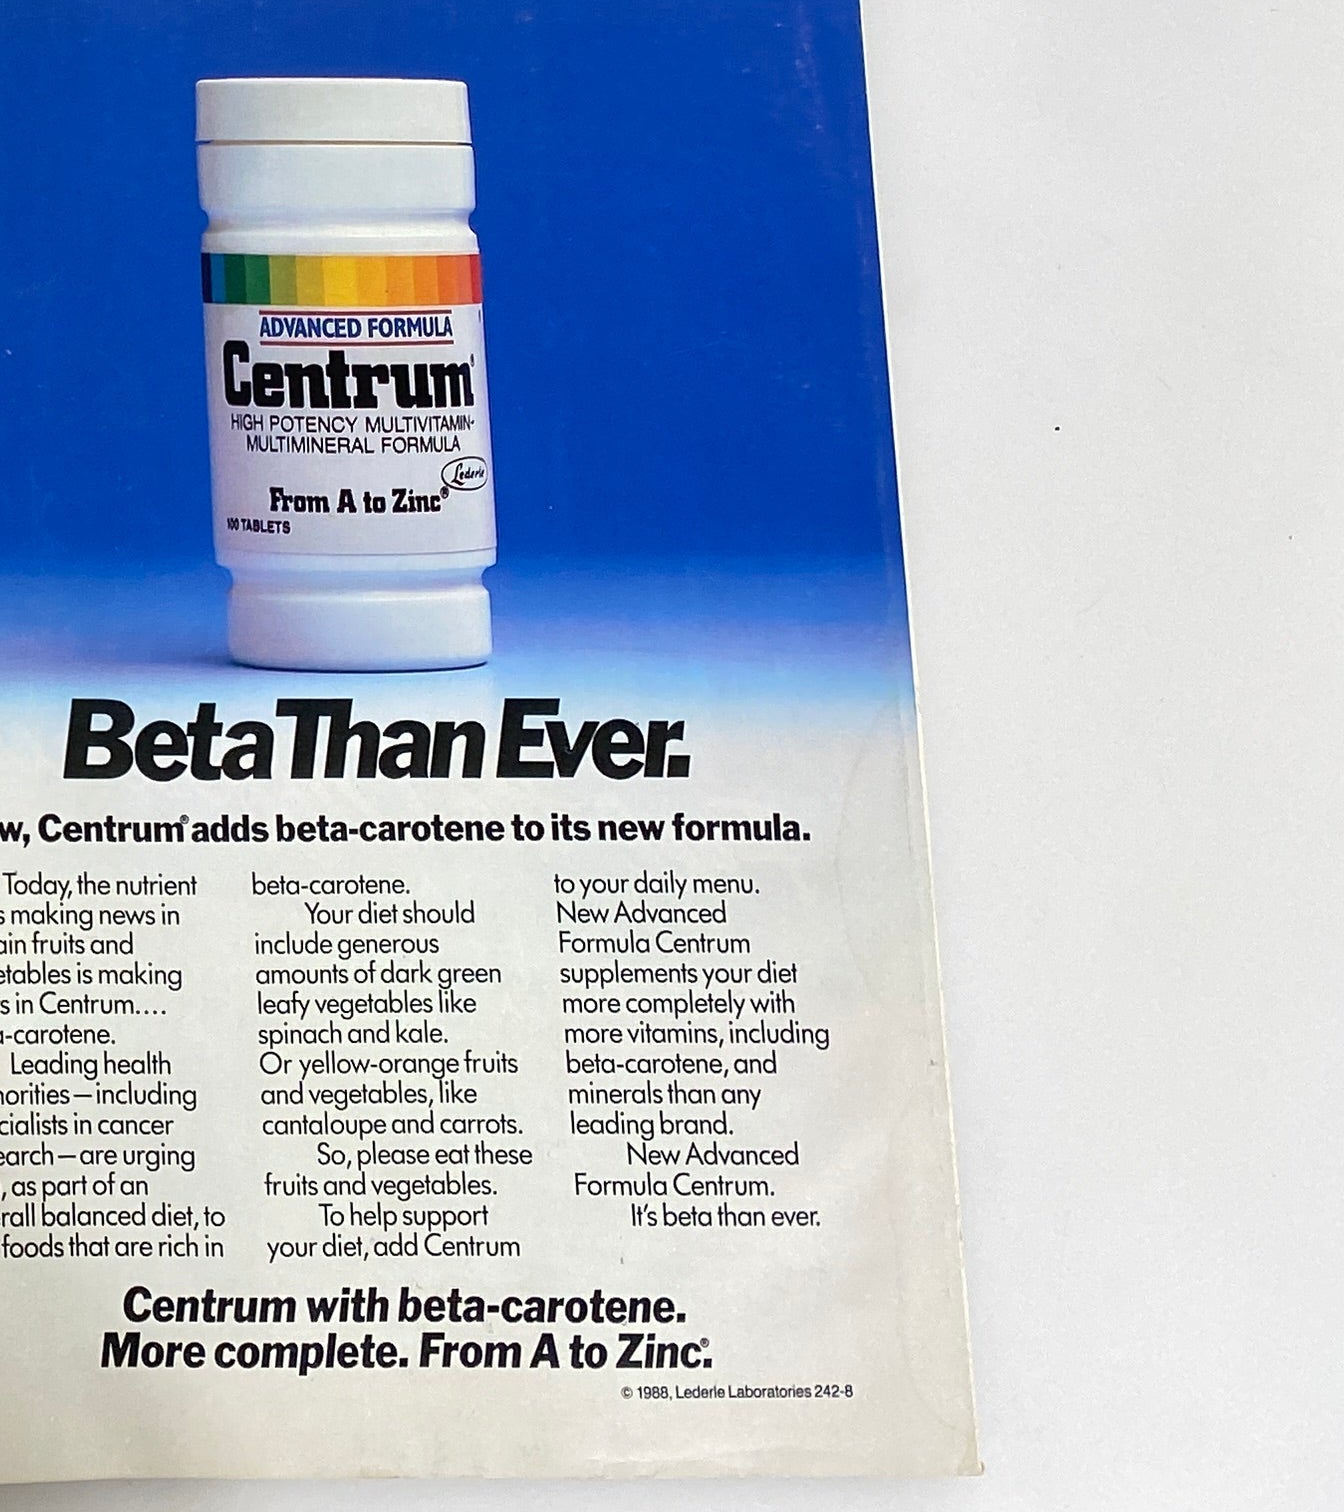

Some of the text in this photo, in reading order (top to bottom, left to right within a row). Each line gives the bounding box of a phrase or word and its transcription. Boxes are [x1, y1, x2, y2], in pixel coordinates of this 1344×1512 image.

[260, 316, 453, 338] ADVANCED FORMULA
[231, 413, 263, 431] HIGH
[270, 415, 358, 433] POTENCY
[247, 434, 461, 454] MULTIMINERAL FORMULA
[241, 518, 291, 534] TABLETS
[63, 698, 691, 782] Beta Than Ever.
[2, 871, 197, 901] Today, the nutrient
[123, 1286, 686, 1324] Centrum with beta-carotene.
[675, 1385, 725, 1399] Lederle
[728, 1385, 812, 1398] Laboratories
[814, 1384, 853, 1398] 242-8
